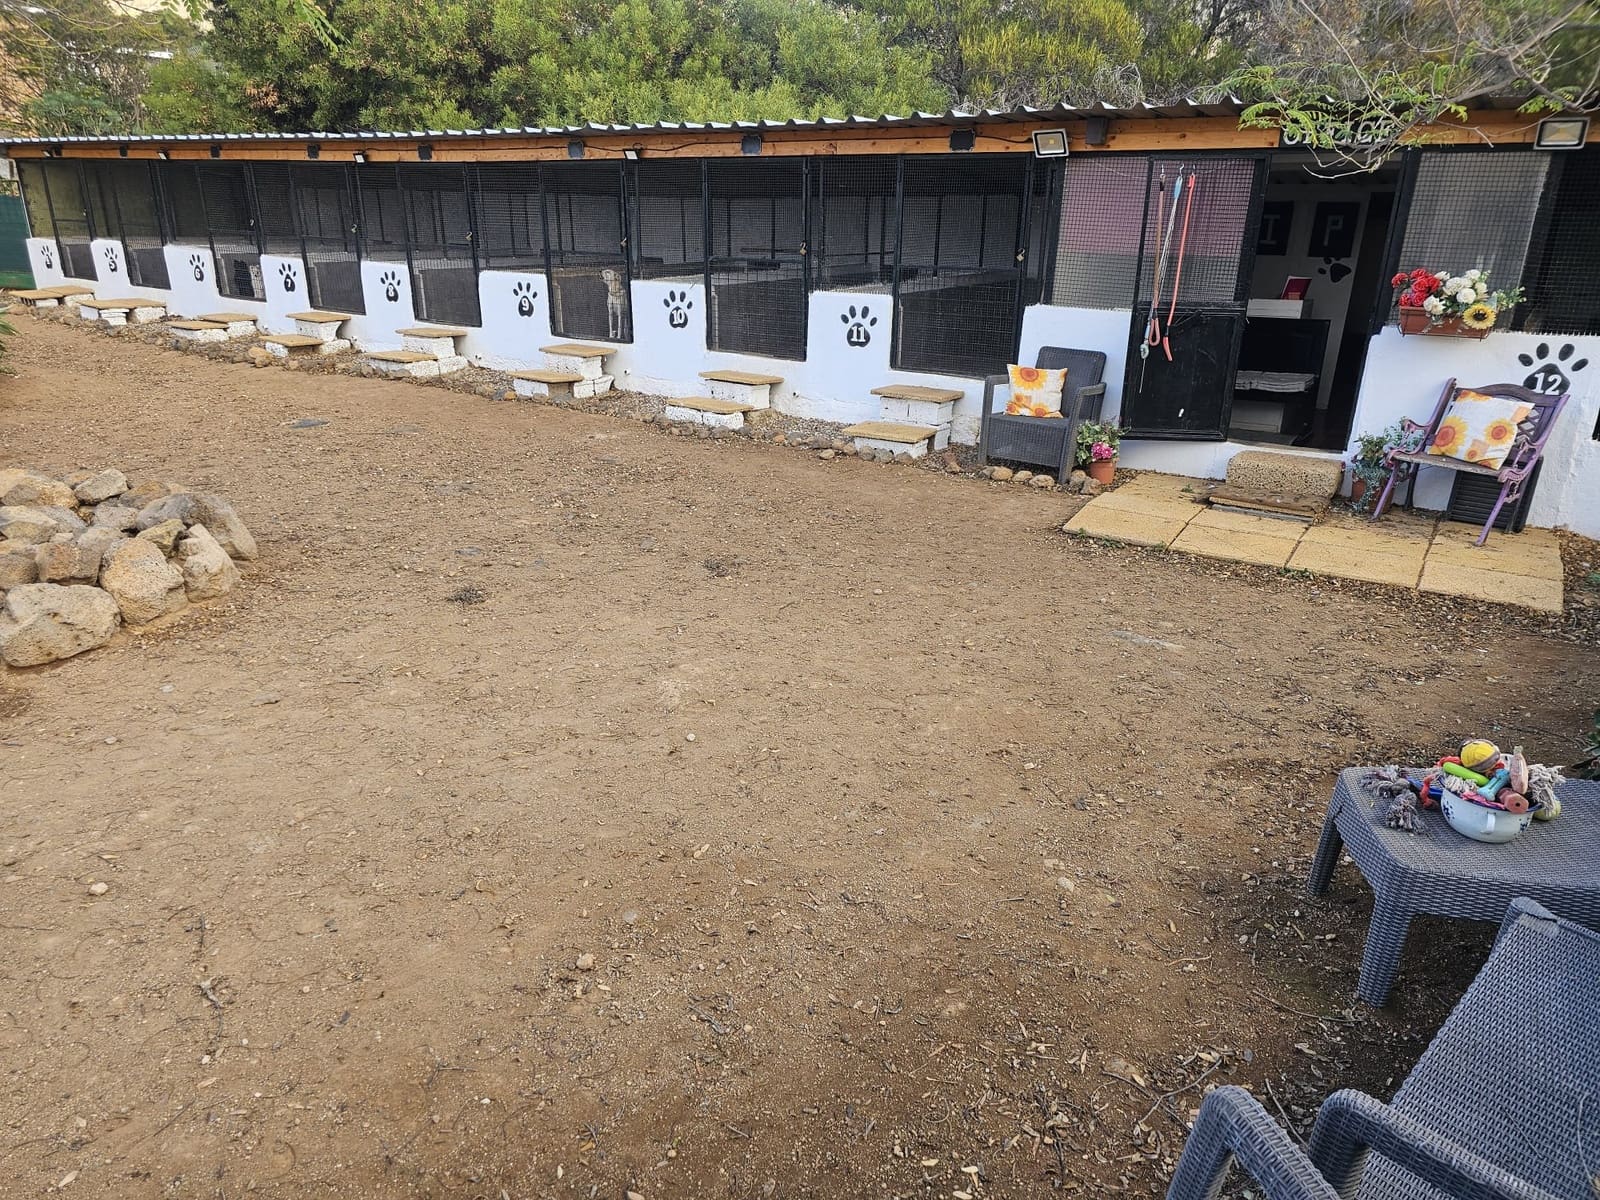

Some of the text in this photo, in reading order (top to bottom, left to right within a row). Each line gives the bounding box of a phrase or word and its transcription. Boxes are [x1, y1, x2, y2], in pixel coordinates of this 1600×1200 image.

[1323, 215, 1345, 247] P
[194, 268, 201, 279] 6
[286, 278, 292, 288] 7
[388, 285, 394, 297] 8
[521, 298, 530, 311] 9
[672, 309, 686, 324] 10
[850, 326, 866, 342] 11
[1531, 372, 1562, 396] 12
